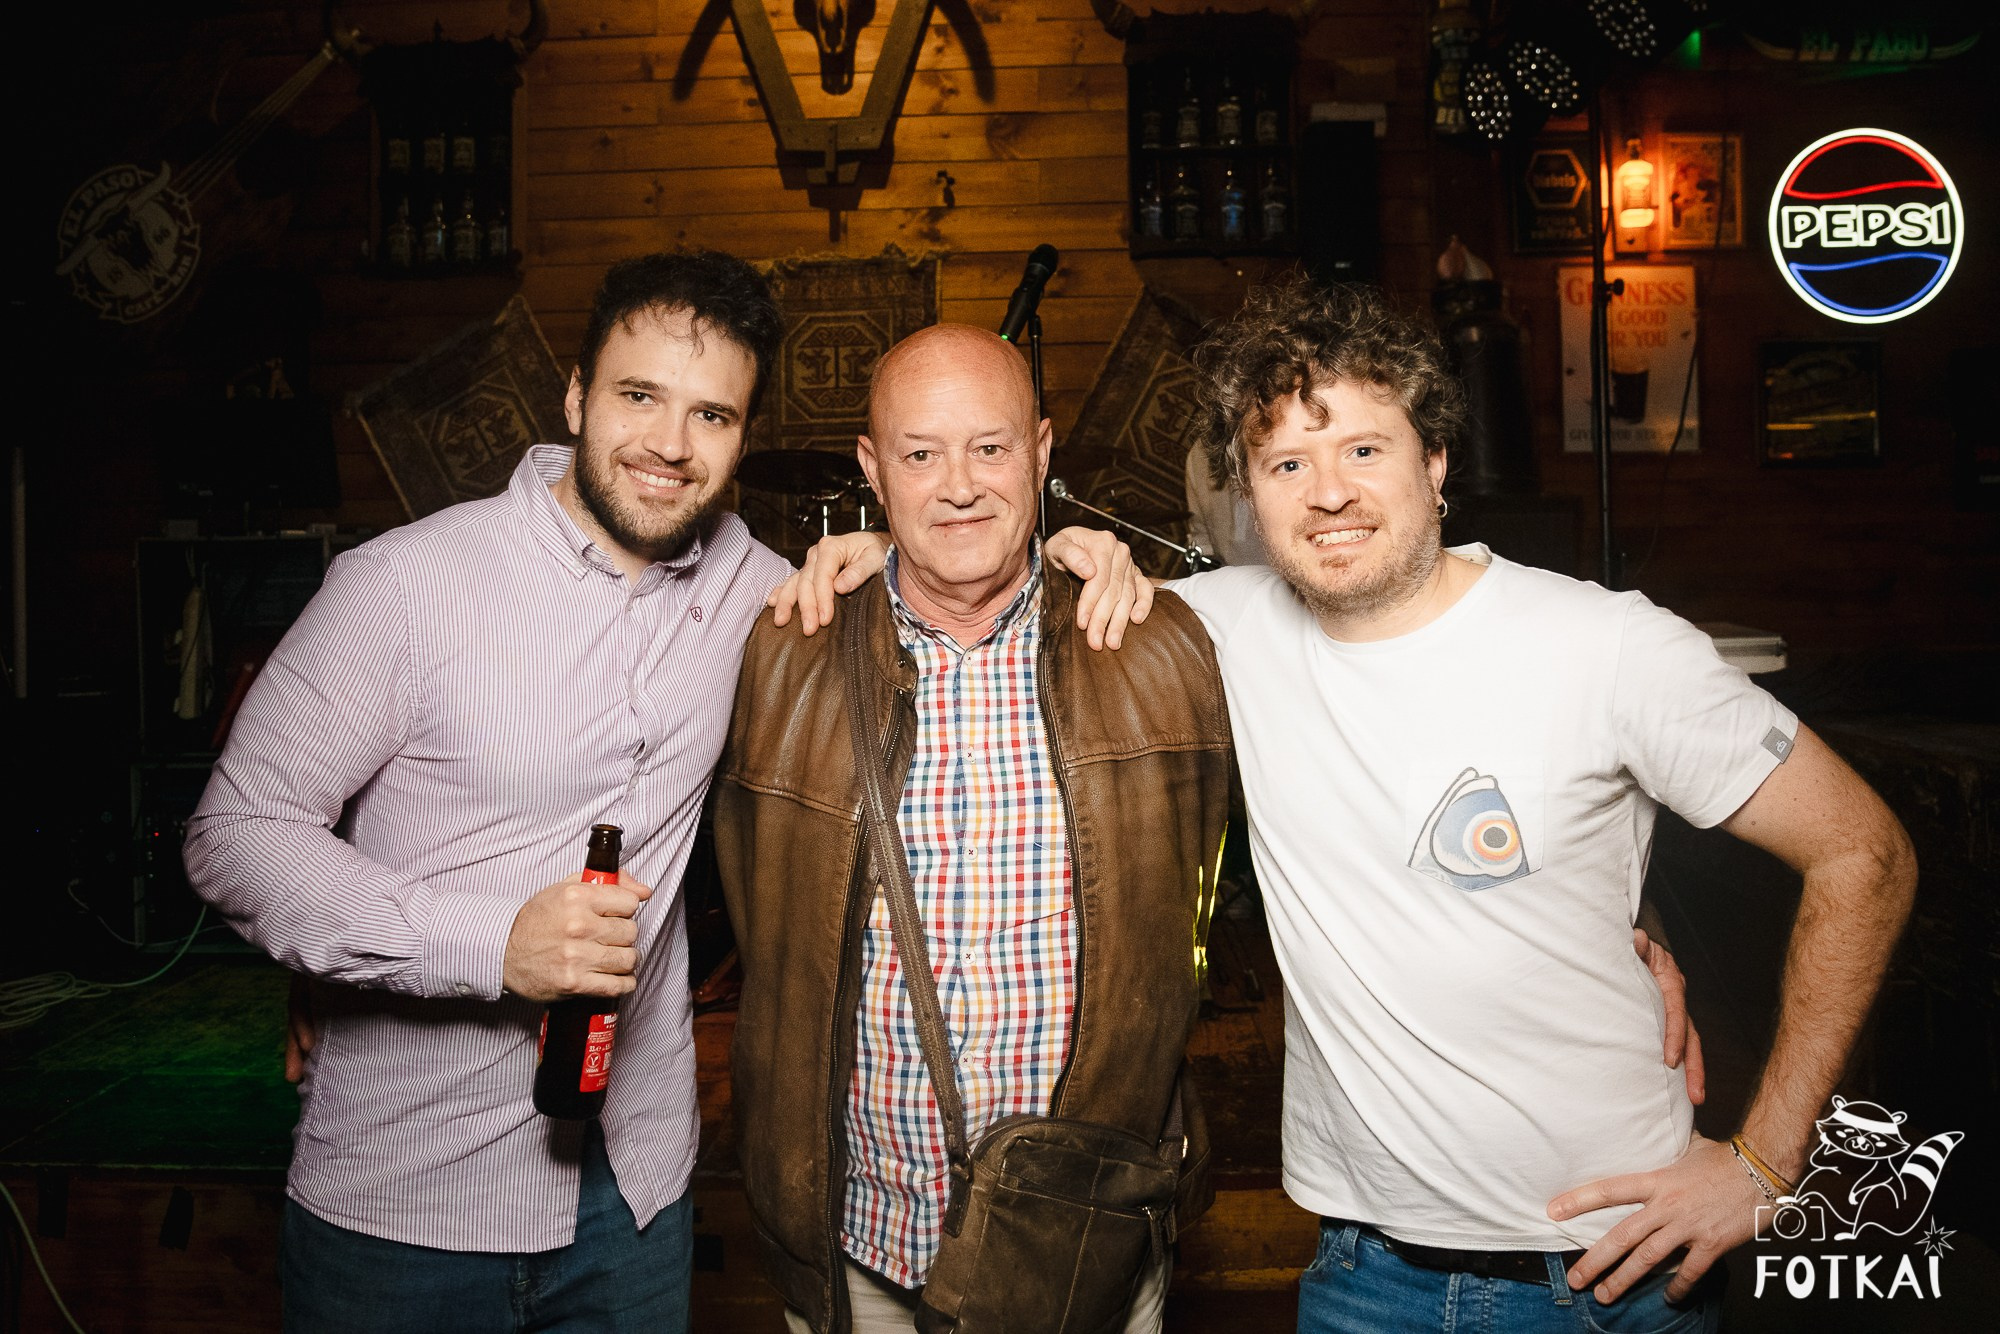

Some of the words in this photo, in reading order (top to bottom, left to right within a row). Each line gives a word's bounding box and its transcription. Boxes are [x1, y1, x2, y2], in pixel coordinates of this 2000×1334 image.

[63, 209, 85, 238] EL
[81, 172, 136, 208] PASO
[1781, 201, 1952, 248] PEPSI
[1617, 308, 1667, 326] GOOD
[1636, 330, 1667, 347] YOU
